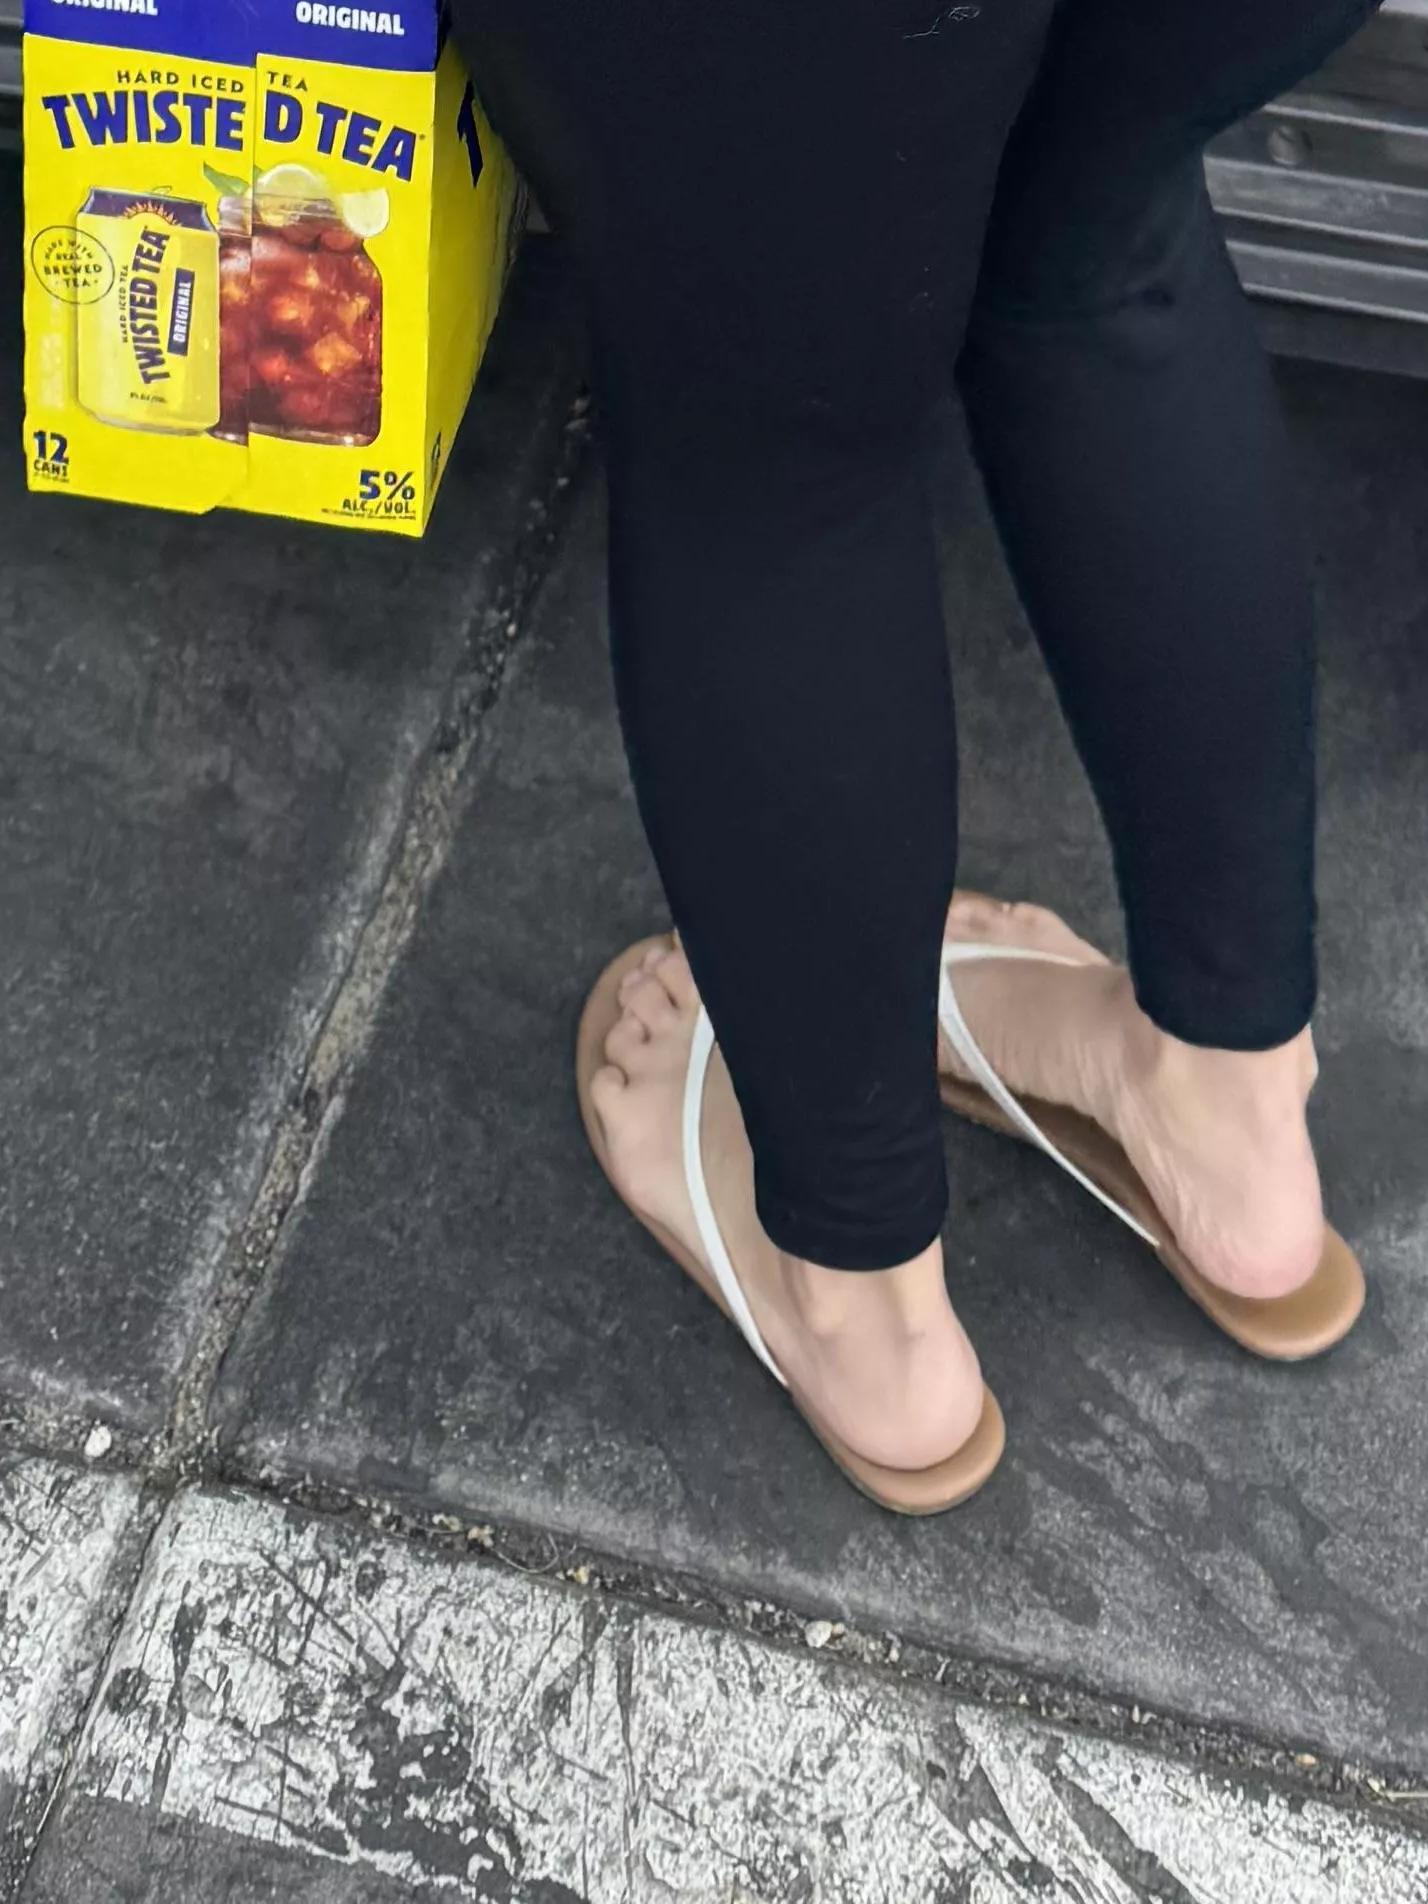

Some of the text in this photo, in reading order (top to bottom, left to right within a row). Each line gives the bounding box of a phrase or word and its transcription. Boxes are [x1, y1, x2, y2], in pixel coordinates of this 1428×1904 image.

[295, 0, 405, 36] ORIGINAL
[116, 70, 309, 93] HARD ICED TEA
[42, 89, 304, 152] TWISTED
[316, 101, 417, 182] TEA
[43, 263, 103, 275] BREWED
[131, 230, 171, 274] TEA
[63, 277, 91, 289] TEA
[118, 264, 129, 343] HARD ICED TEA
[172, 281, 192, 343] ORIGINAL
[129, 277, 171, 385] TWISTED
[32, 430, 69, 464] 12
[33, 459, 68, 477] CANS
[358, 468, 416, 501] 5%
